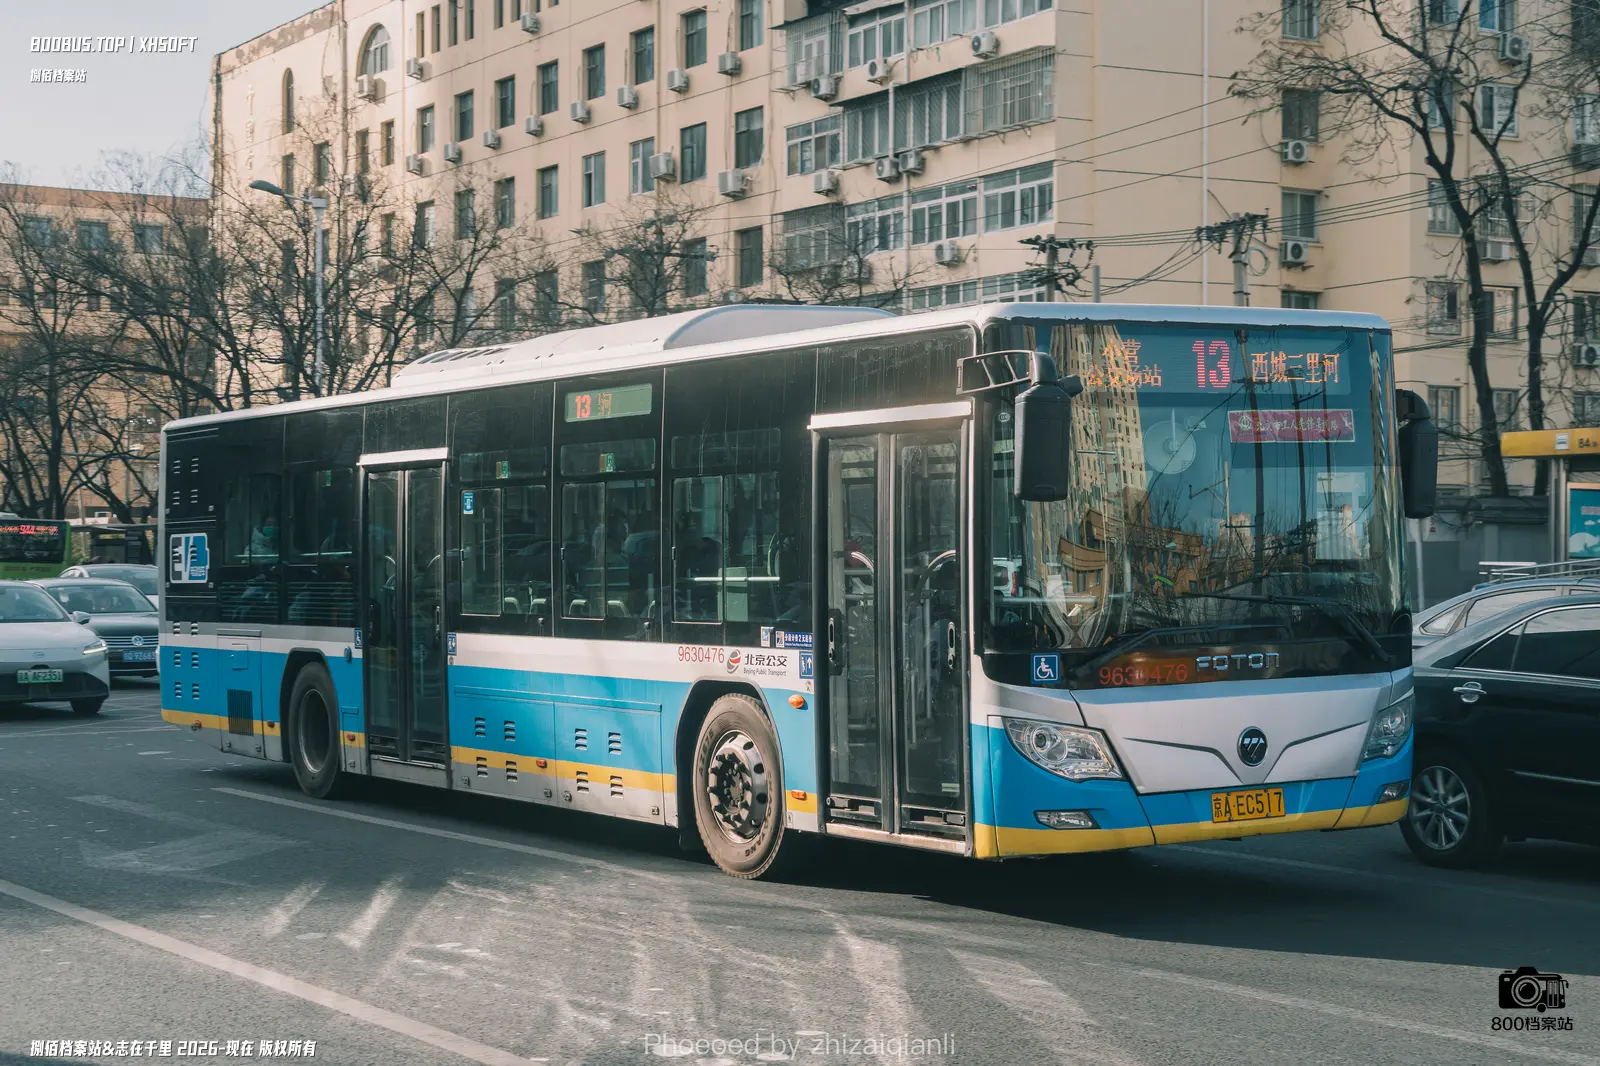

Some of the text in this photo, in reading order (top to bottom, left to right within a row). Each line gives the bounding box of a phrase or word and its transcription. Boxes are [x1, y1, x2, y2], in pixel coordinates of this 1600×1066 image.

[1192, 340, 1230, 388] 13
[1250, 351, 1340, 383] 西城三里河
[575, 394, 591, 419] 13
[677, 646, 725, 664] 9630476
[744, 653, 788, 667] 北京公交
[1196, 652, 1279, 672] FOTON
[1099, 663, 1188, 686] 9630476
